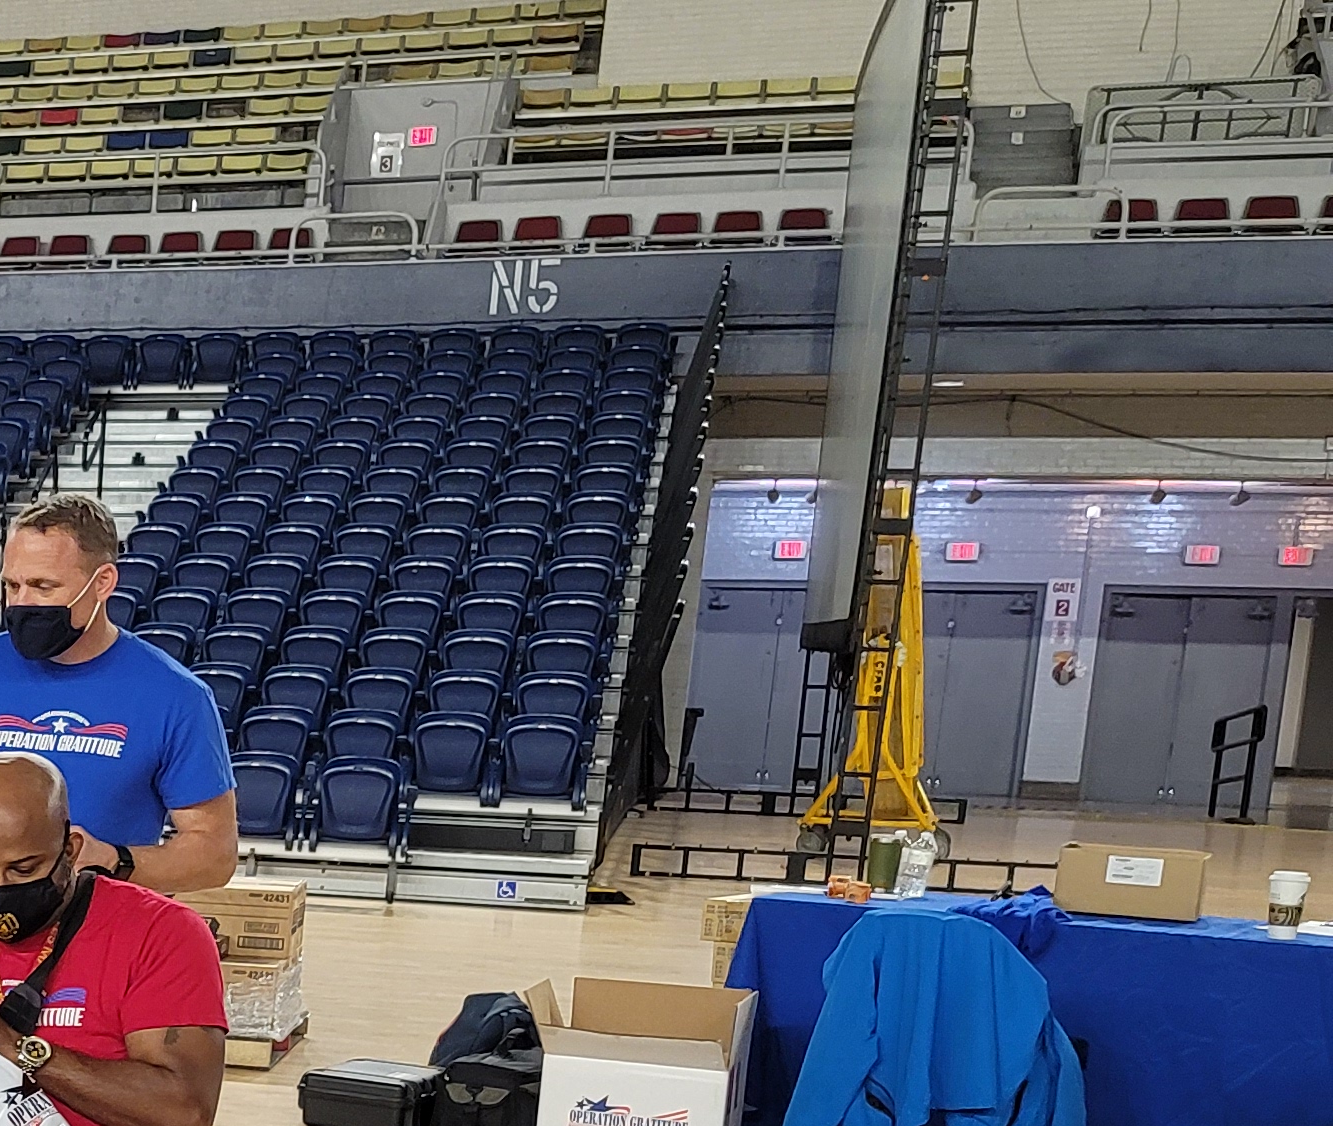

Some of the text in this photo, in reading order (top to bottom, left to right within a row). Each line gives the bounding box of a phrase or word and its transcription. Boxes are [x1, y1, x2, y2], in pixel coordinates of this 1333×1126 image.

[381, 157, 391, 172] 3
[488, 258, 562, 315] N5
[1052, 582, 1076, 594] GATE
[1057, 601, 1068, 615] 2
[56, 734, 126, 759] GRATITUDE
[263, 894, 290, 903] 42431
